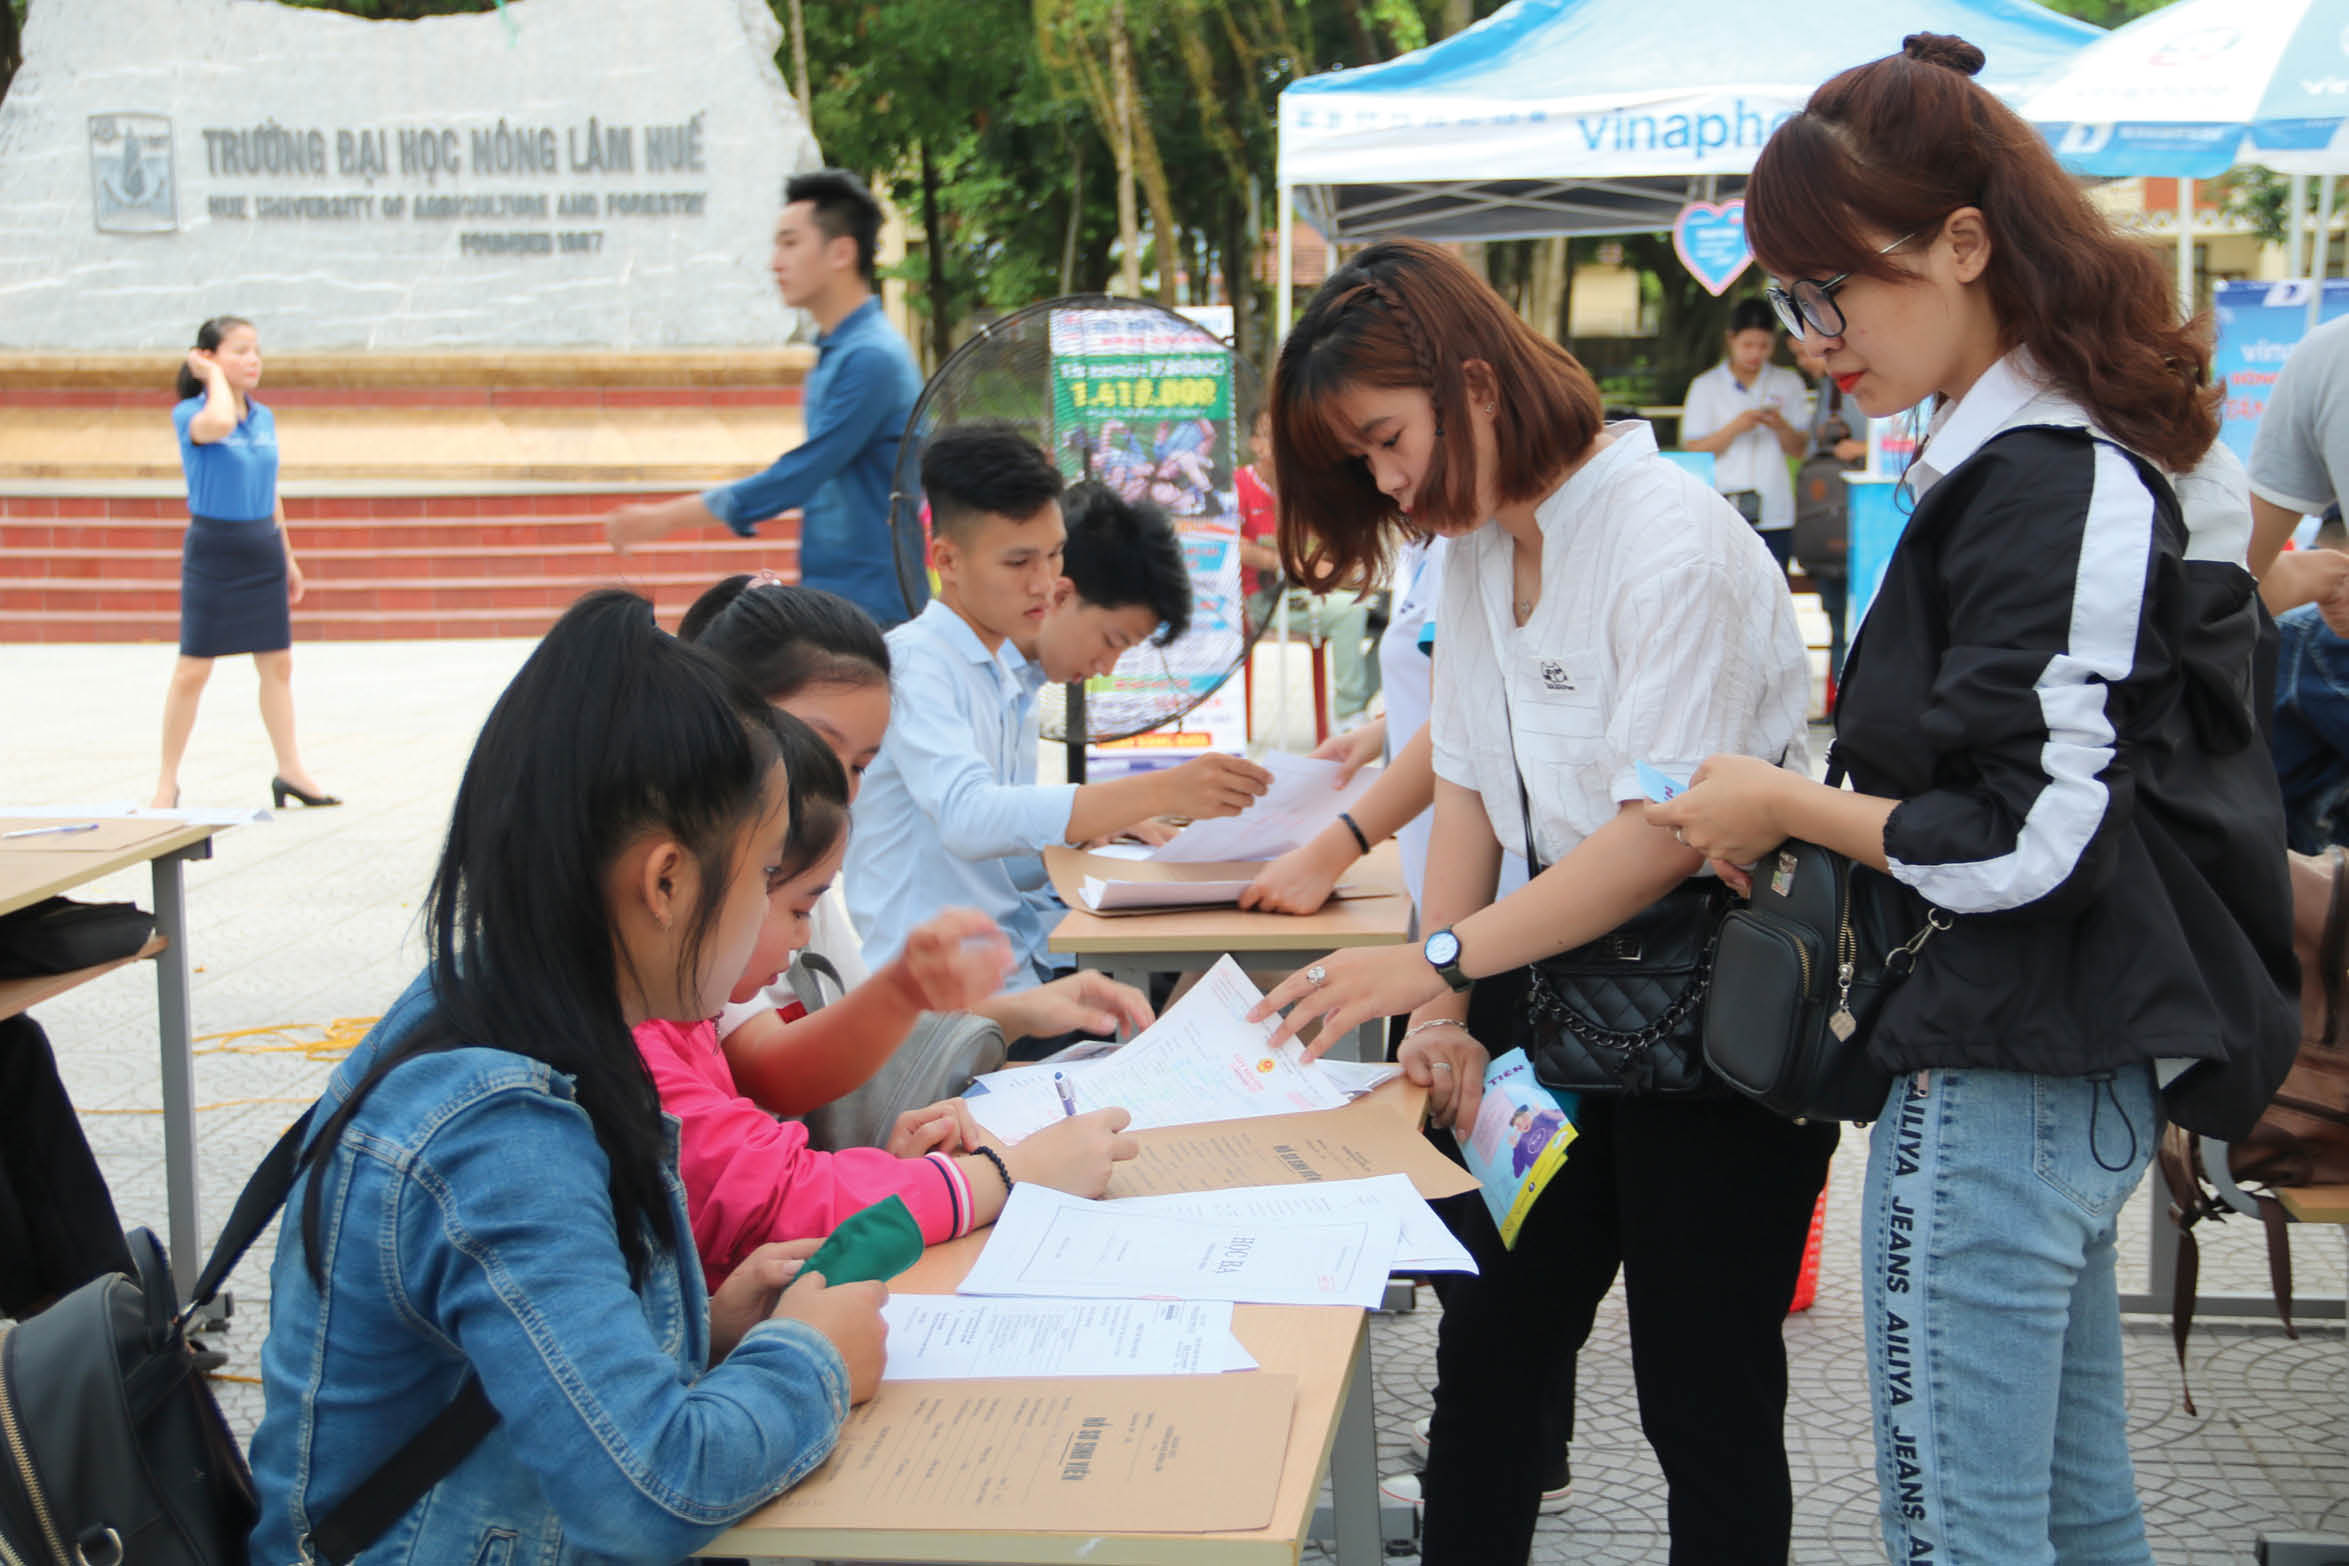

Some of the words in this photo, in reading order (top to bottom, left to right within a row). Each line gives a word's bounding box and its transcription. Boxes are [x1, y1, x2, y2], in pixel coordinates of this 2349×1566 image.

[202, 116, 326, 176] TRƯỜNG
[336, 129, 388, 186] ĐẠI
[399, 128, 460, 187] HỌC
[568, 115, 634, 173] LÂM
[645, 109, 706, 172] HUẾ
[1886, 1196, 1914, 1294] JEANS
[1886, 1311, 1914, 1407] AILIYA
[1892, 1425, 1926, 1522] JEANS
